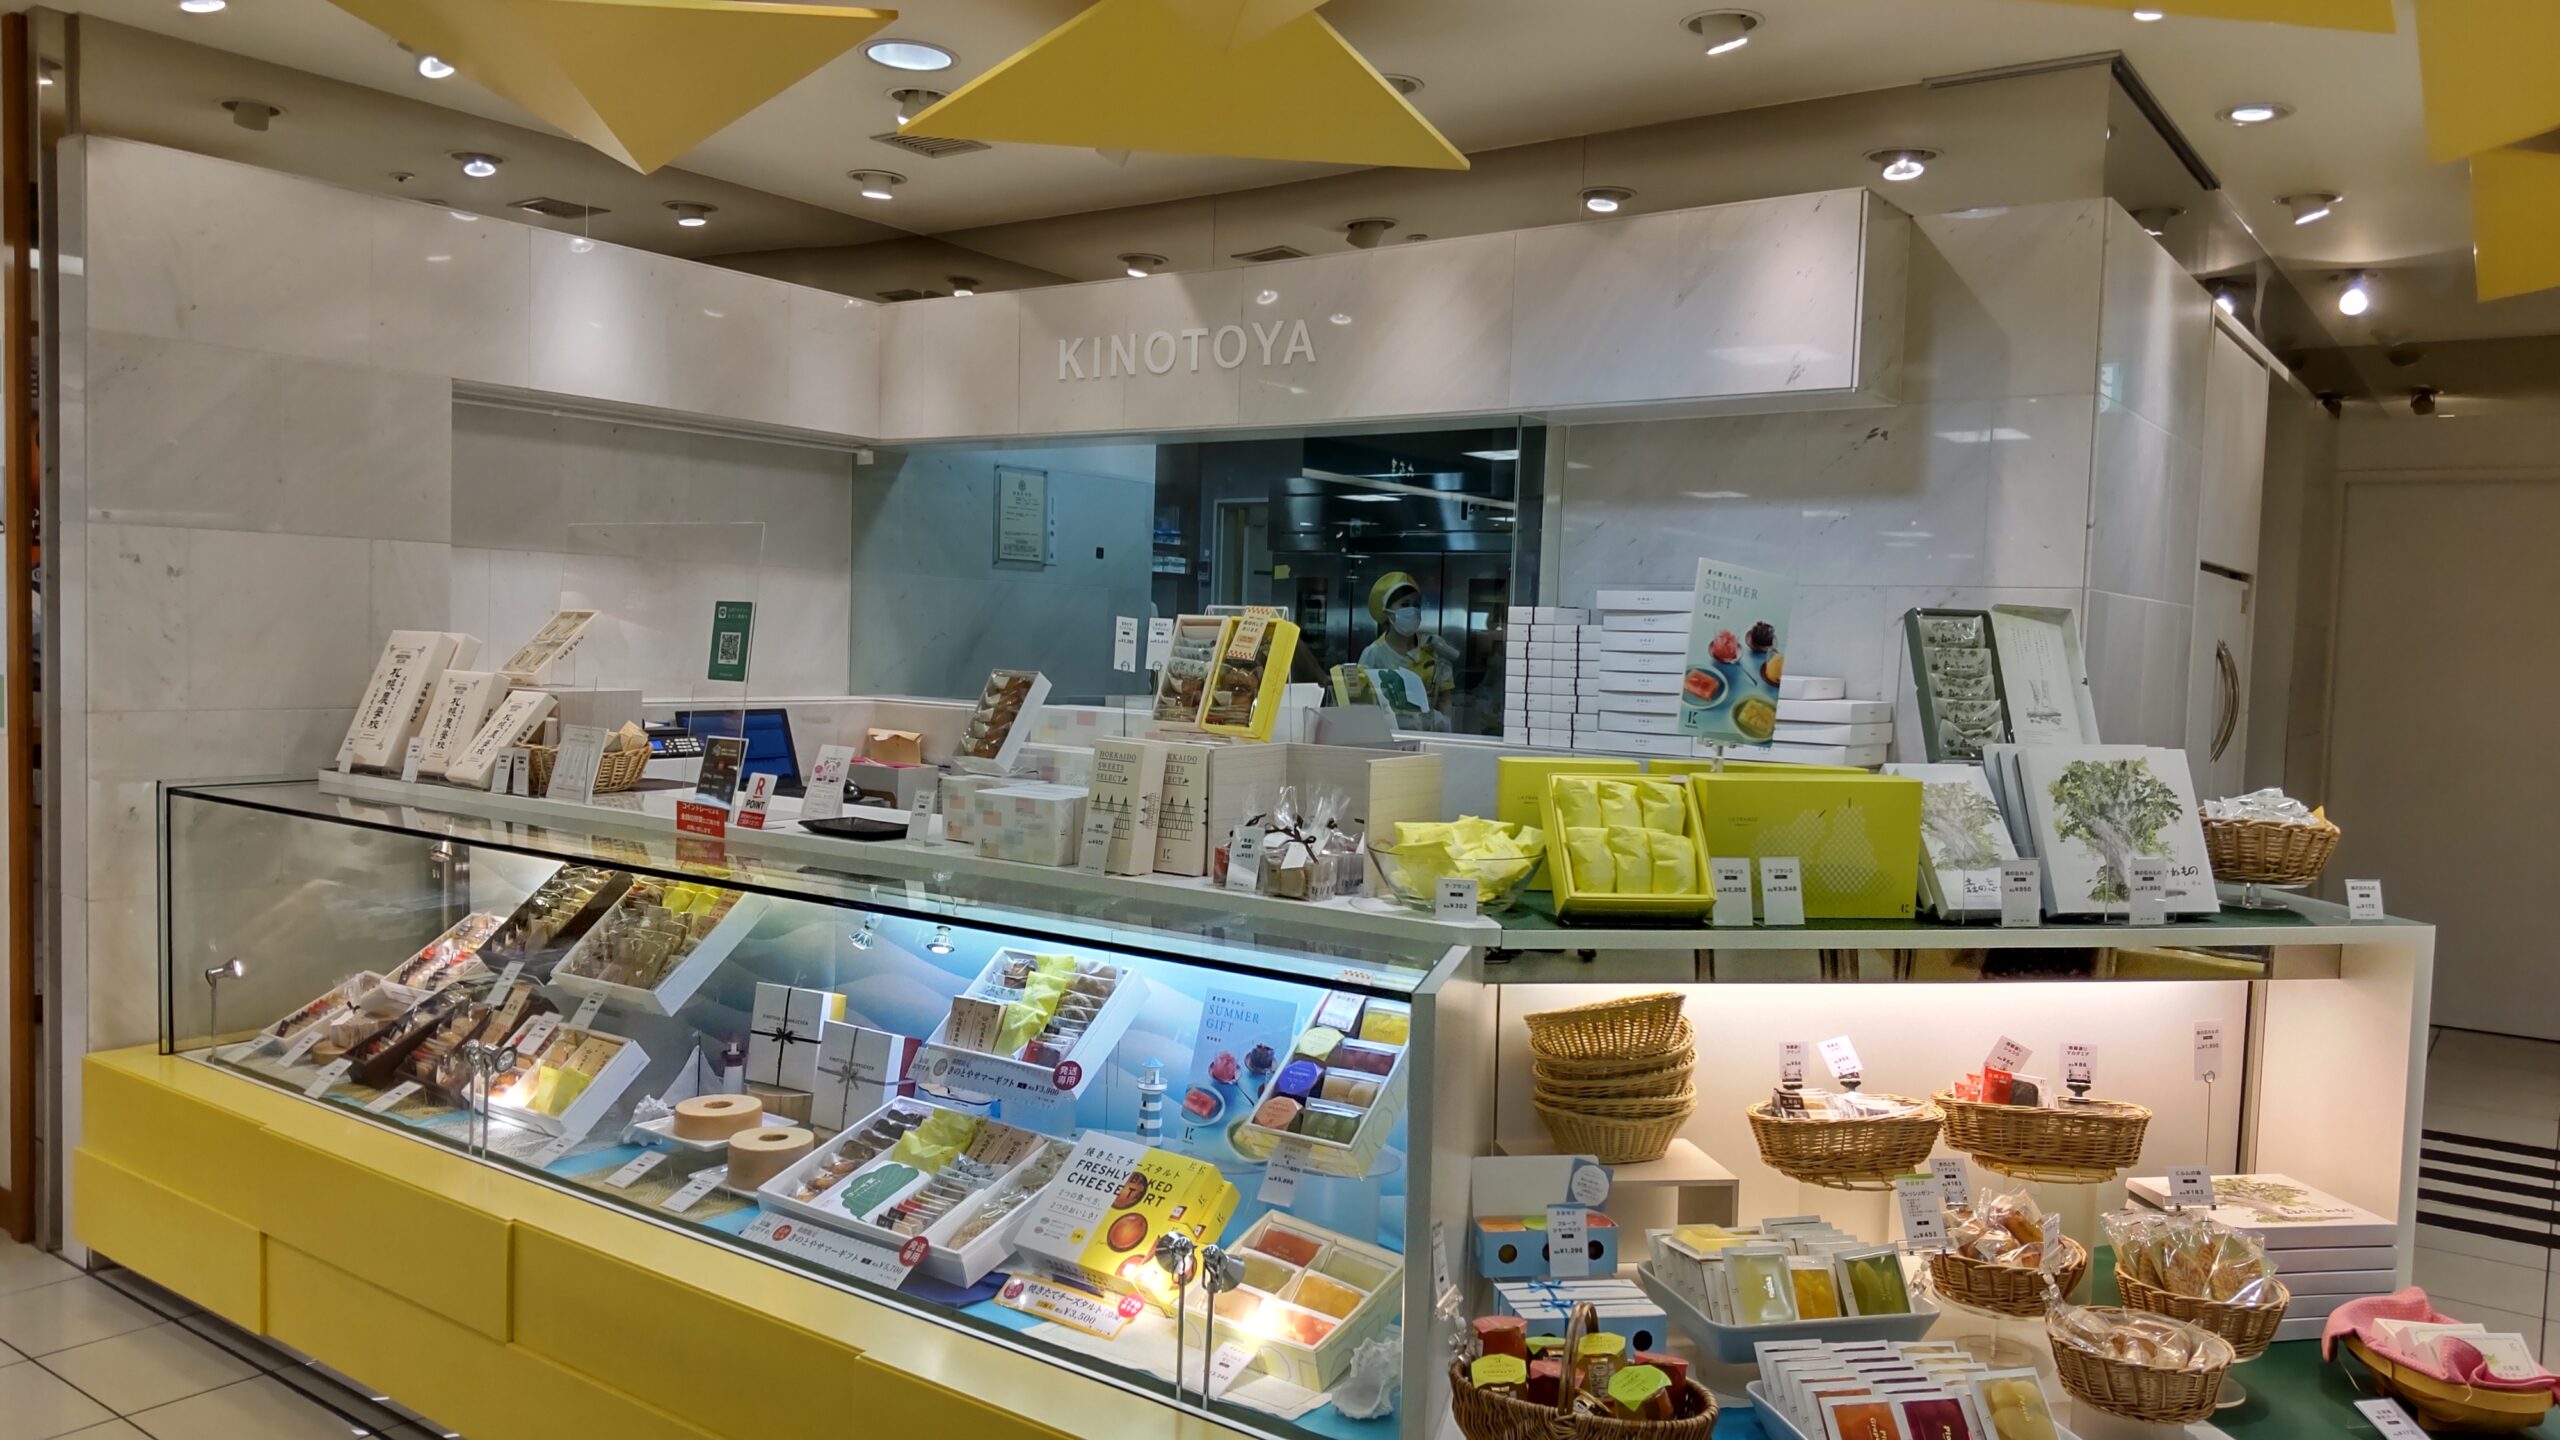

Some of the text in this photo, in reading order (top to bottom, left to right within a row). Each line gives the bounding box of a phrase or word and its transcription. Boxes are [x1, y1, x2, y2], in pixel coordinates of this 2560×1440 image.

[1058, 319, 1316, 380] KINOTOYA
[1704, 579, 1758, 600] SUMMER
[1702, 593, 1733, 609] GIFT
[1100, 751, 1137, 762] HOKKAIDO
[1167, 752, 1198, 762] KKAIDO
[1098, 762, 1125, 772] SWEETS
[754, 777, 766, 796] R
[1096, 773, 1122, 782] SELECT
[746, 800, 766, 810] POINT
[1208, 1004, 1260, 1024] SUMMER
[1206, 1019, 1234, 1033] GIFT
[947, 1066, 1015, 1088] きのとやサマーギフト
[1060, 1066, 1078, 1076] 発送
[1057, 1076, 1076, 1086] 専用
[1076, 1159, 1130, 1181] FRESHLY
[1084, 1147, 1181, 1179] 焼きたてチーズタルト
[1067, 1172, 1123, 1196] CHEESE
[1058, 1189, 1102, 1209] 2つの食べ方、
[1050, 1202, 1098, 1221] 2つのおいしさ!
[788, 1232, 858, 1262] きのとやサマーギフト
[909, 1240, 927, 1254] 発送
[1028, 1284, 1102, 1314] 焼きたてチーズタルト
[2018, 1394, 2032, 1422] Peach
